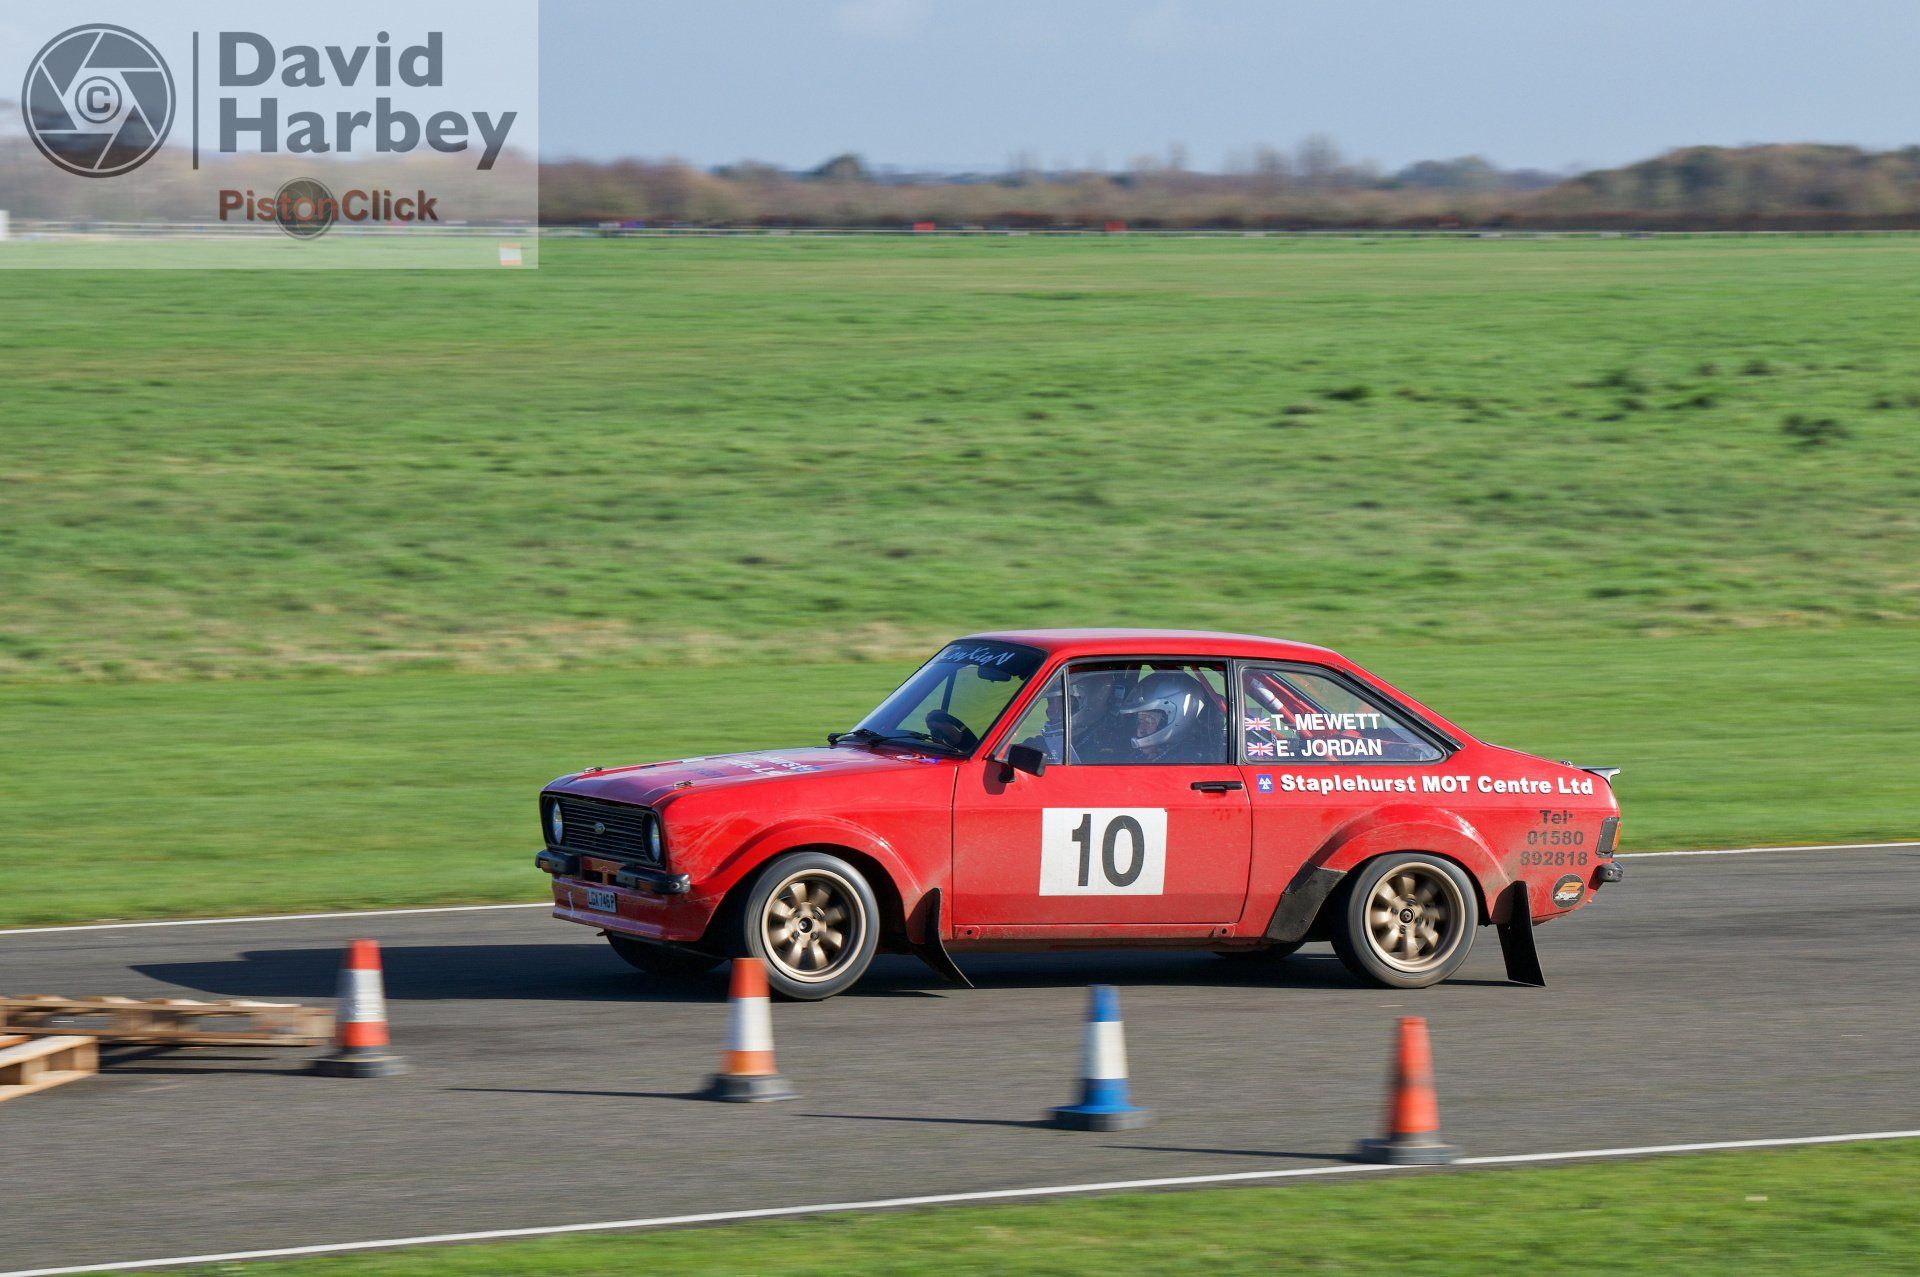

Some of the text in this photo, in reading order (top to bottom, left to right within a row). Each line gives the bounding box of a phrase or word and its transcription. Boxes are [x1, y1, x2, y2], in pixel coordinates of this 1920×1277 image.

[1271, 713, 1381, 731] T. MEWETT
[1276, 739, 1383, 758] E. JORDAN
[1280, 774, 1594, 796] Staplehurst MOT Centre Ltd
[1526, 830, 1584, 846] 01580
[1071, 813, 1145, 888] 10
[1519, 851, 1588, 867] 892818
